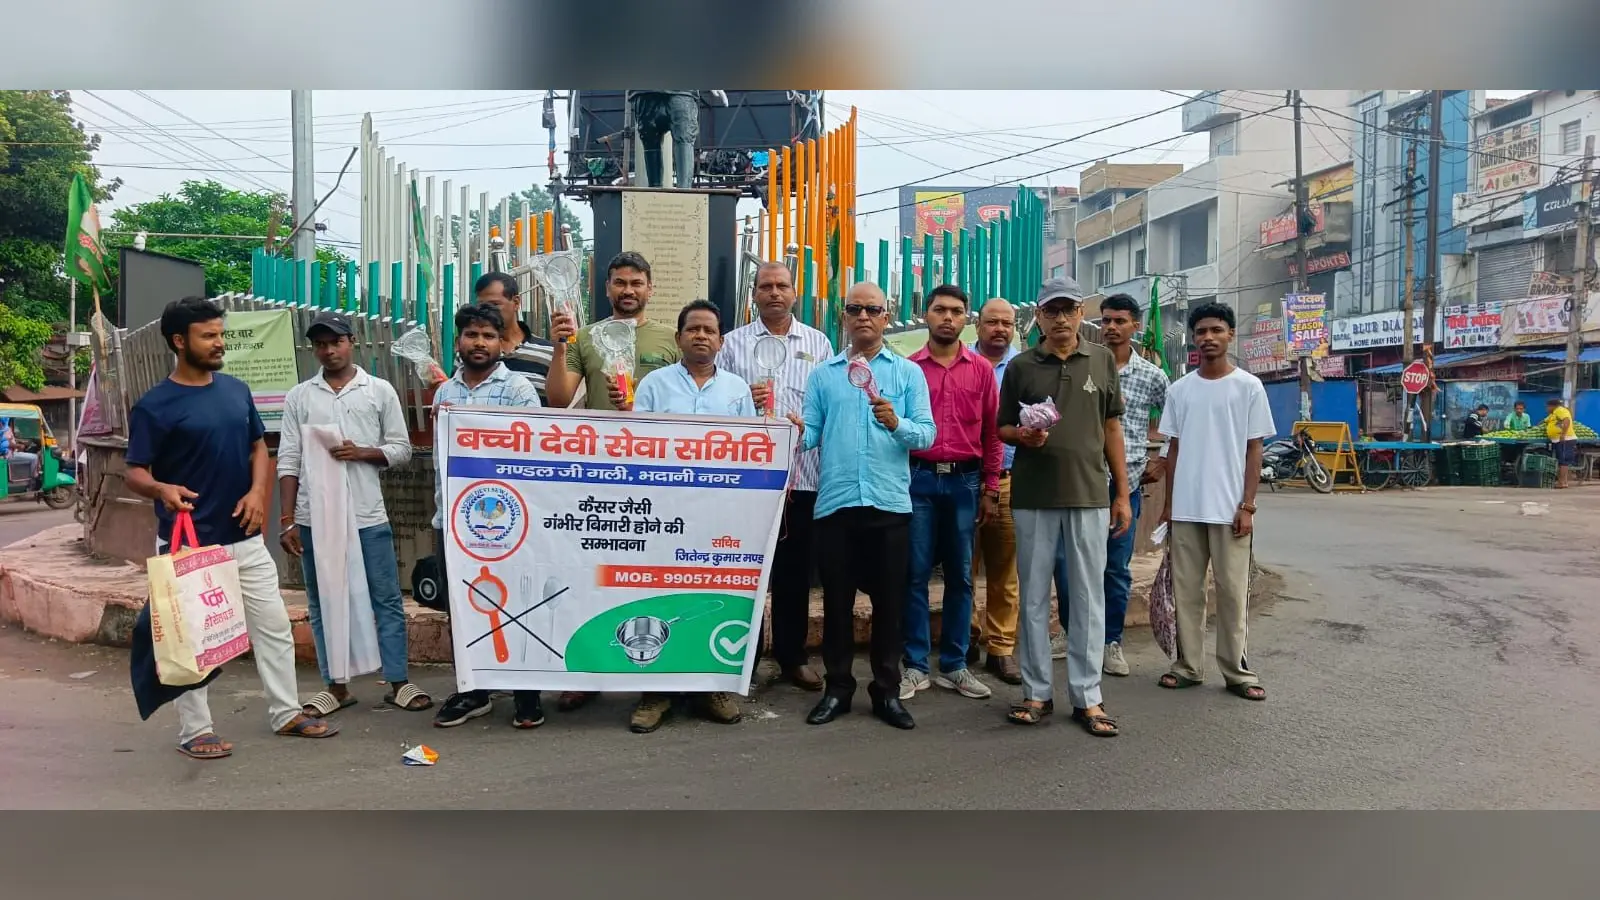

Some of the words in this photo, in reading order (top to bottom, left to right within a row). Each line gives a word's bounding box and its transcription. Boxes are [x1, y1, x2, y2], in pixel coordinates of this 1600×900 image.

[1308, 253, 1346, 271] SPORTS
[1291, 321, 1324, 332] SEASON
[1353, 322, 1379, 335] BLUE
[1295, 329, 1324, 341] SALE
[1404, 371, 1427, 384] STOP
[455, 421, 534, 453] बच्ची
[539, 424, 599, 456] देवी
[604, 427, 669, 459] सेवा
[674, 430, 776, 463] समिति
[495, 463, 556, 478] मण्डल
[557, 463, 584, 479] जी
[587, 465, 634, 482] गली,
[638, 468, 694, 483] भदानी
[697, 471, 742, 485] नगर
[578, 495, 617, 514] कैंसर
[618, 496, 652, 515] जैसी
[543, 513, 584, 532] गंभीर
[633, 516, 662, 535] होने
[664, 516, 685, 535] की
[580, 537, 647, 552] सम्भावना
[711, 535, 741, 549] सचिव
[675, 548, 710, 564] जितेन्द्र
[712, 552, 742, 566] कुमार
[615, 571, 658, 583] MOB-
[664, 572, 759, 586] 9905744880
